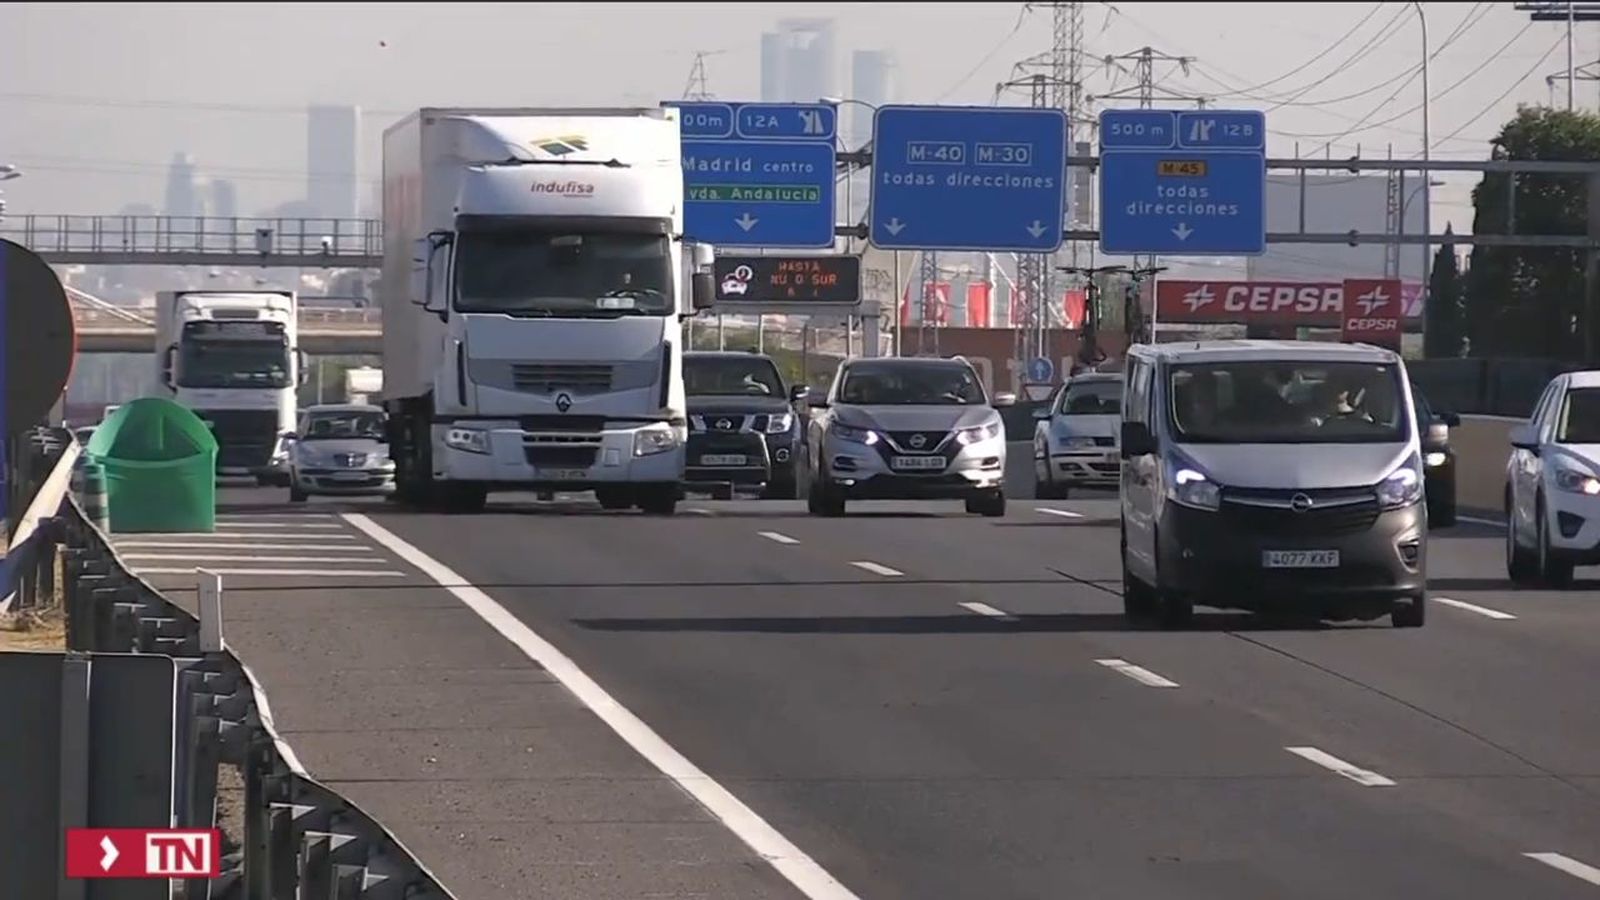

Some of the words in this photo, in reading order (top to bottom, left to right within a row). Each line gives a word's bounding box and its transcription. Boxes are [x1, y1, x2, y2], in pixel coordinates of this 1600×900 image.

[682, 113, 723, 127] 00m
[746, 115, 779, 128] 12A
[1111, 123, 1145, 136] 500
[1151, 126, 1164, 136] m
[1223, 124, 1253, 137] 12B
[910, 145, 962, 161] M-40
[978, 147, 1028, 162] M-30
[682, 157, 752, 172] Madrid
[763, 162, 814, 173] centro
[883, 171, 935, 186] todas
[946, 172, 1054, 189] direcciones
[530, 181, 595, 194] indufisa
[688, 188, 721, 200] vda.
[1157, 185, 1210, 198] todas
[1126, 200, 1239, 216] direcciones
[812, 273, 838, 285] SUR
[1224, 286, 1343, 313] CEPSA
[1346, 317, 1398, 331] CEPSA
